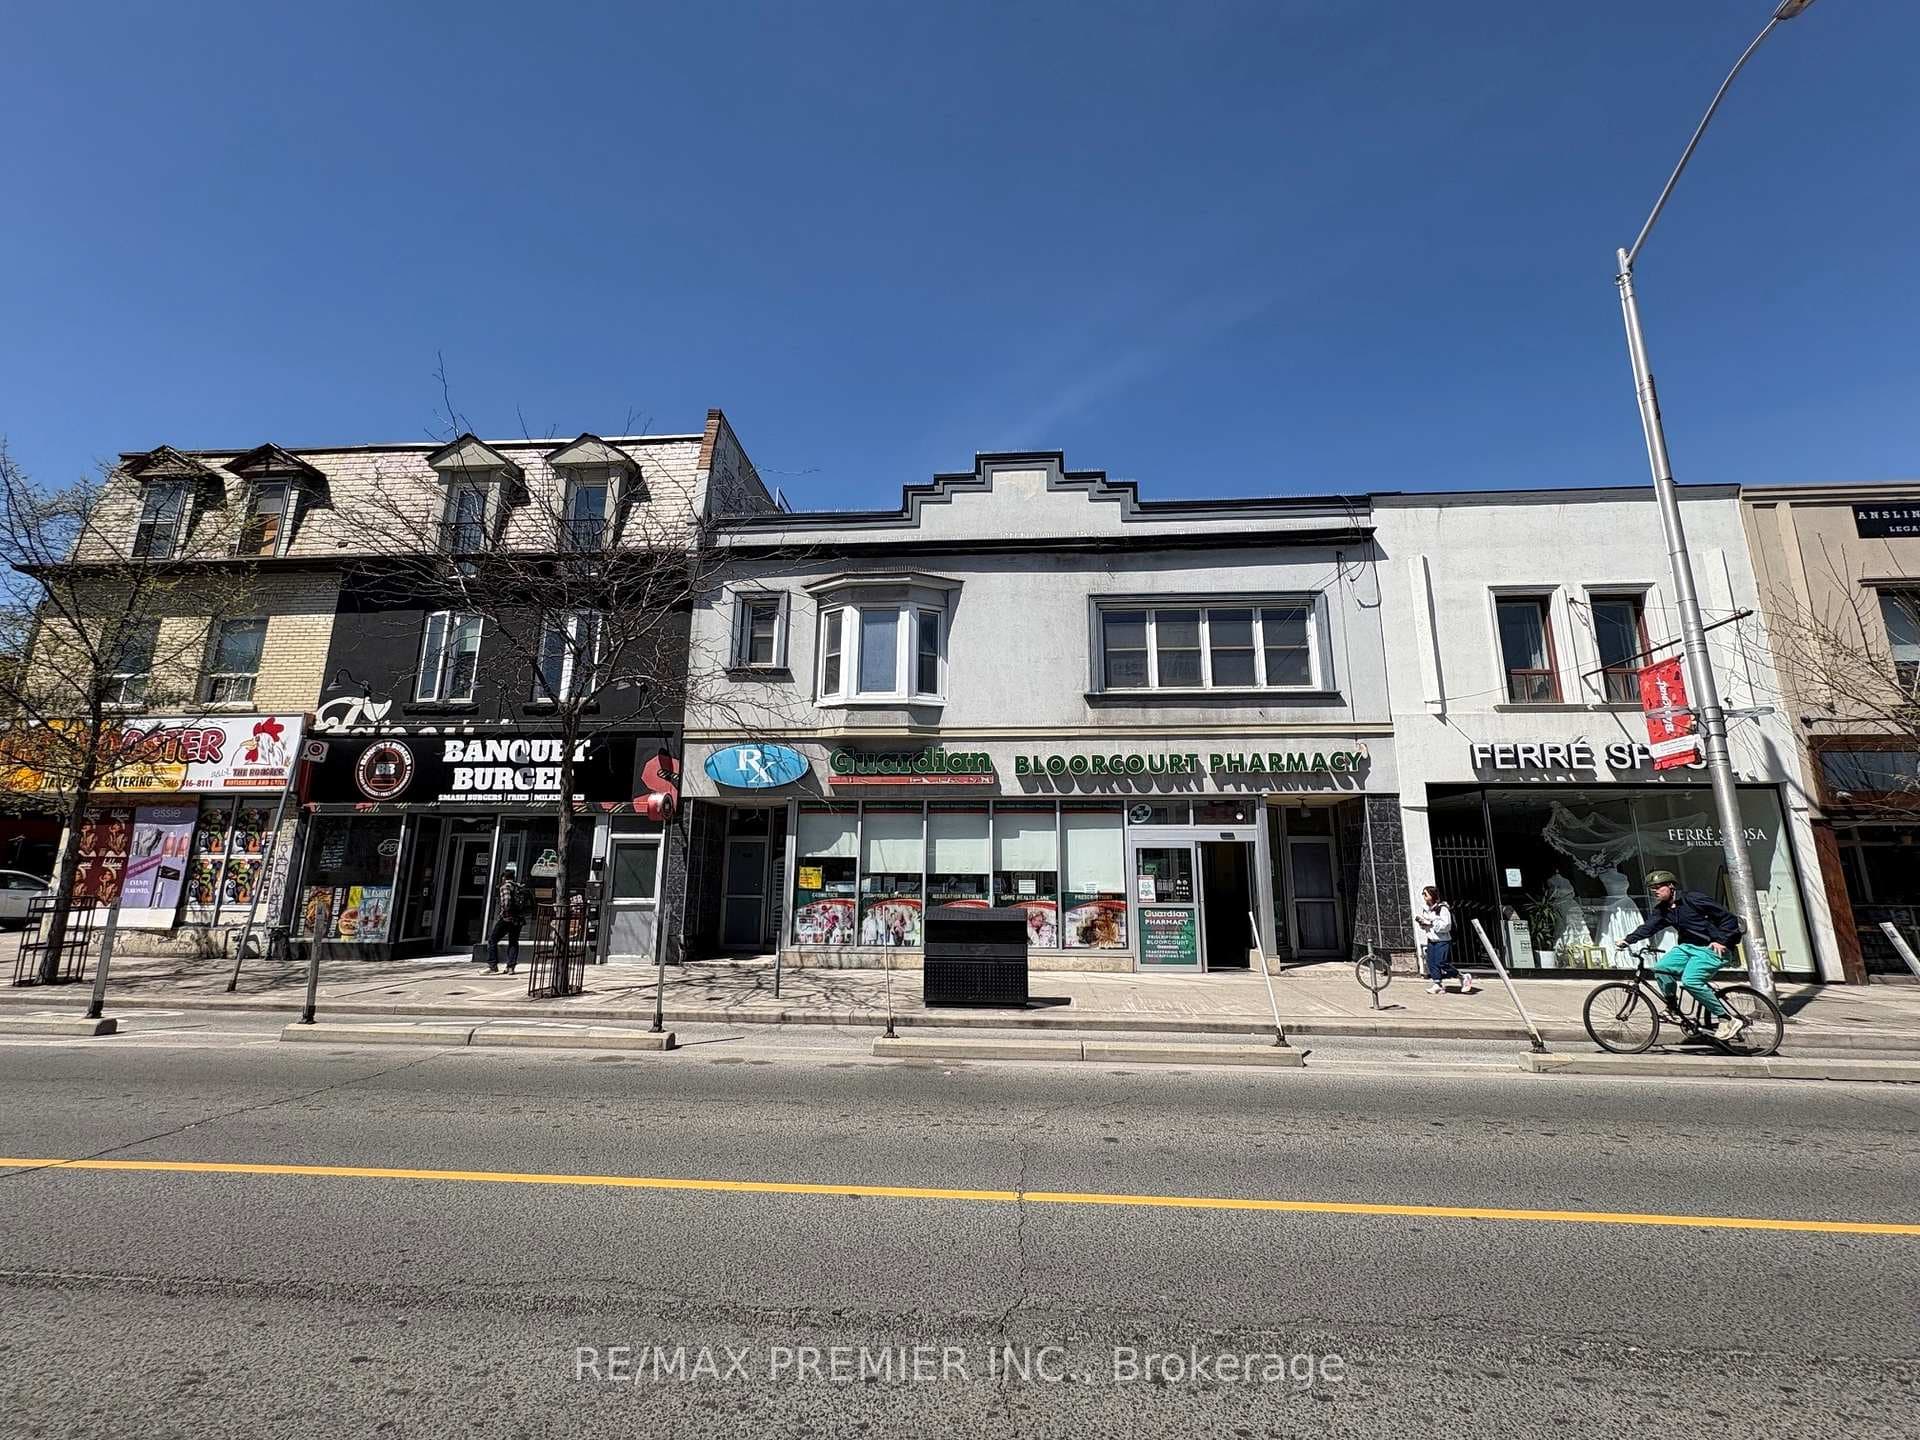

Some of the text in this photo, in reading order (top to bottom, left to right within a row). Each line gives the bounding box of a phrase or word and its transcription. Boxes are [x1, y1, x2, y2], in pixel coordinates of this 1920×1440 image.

[829, 746, 992, 775] Guardian
[1014, 751, 1364, 776] BLOORCOURT PHARMACY
[1474, 736, 1595, 769] FERRÉ
[452, 767, 574, 791] BURGE
[152, 807, 182, 818] essie
[1667, 826, 1715, 841] FERRÉ
[1144, 909, 1189, 918] Guardian
